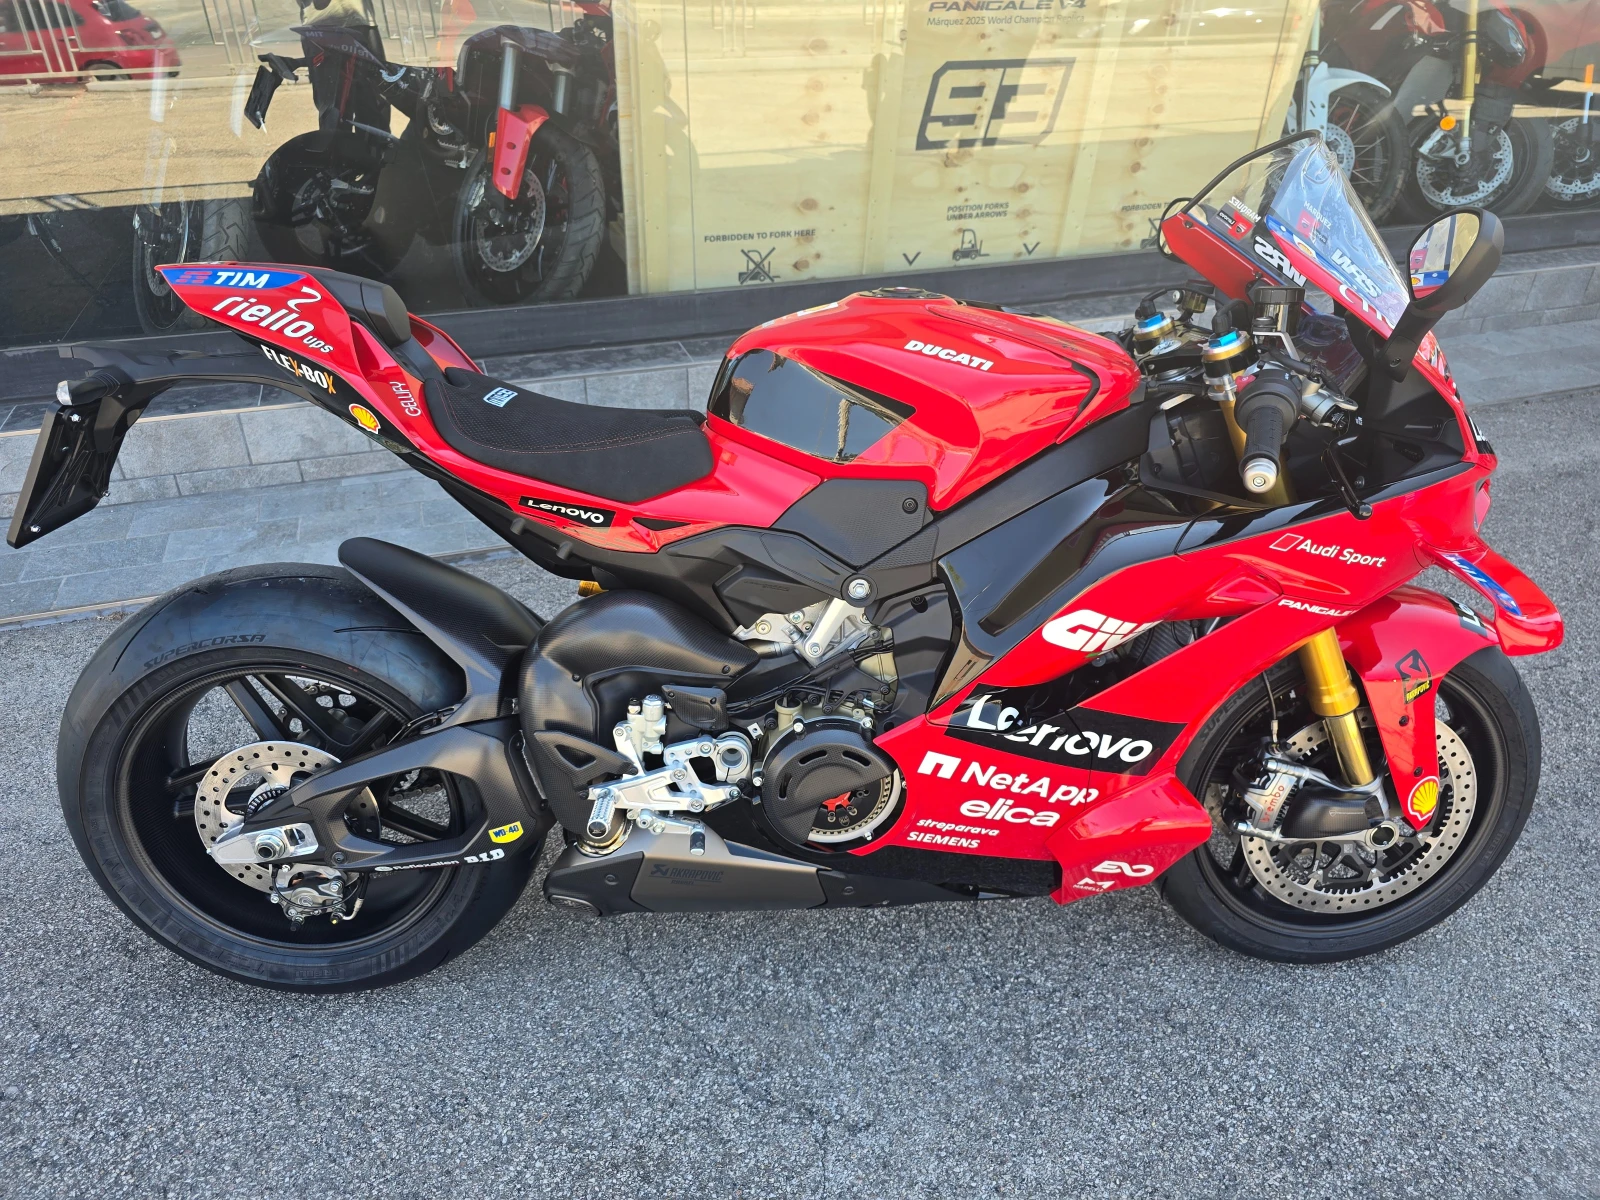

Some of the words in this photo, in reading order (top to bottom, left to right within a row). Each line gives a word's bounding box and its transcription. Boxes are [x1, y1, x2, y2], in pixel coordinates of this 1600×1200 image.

[927, 17, 964, 27] Márquez
[966, 16, 986, 24] 2025
[988, 15, 1012, 24] World
[946, 213, 972, 221] UNDER
[974, 210, 1007, 220] ARROWS
[947, 204, 981, 213] POSITION
[984, 202, 1009, 211] FORKS
[704, 233, 754, 243] FORBIDDEN
[757, 232, 768, 240] TO
[769, 230, 792, 239] FORK
[794, 229, 816, 238] HERE
[214, 271, 270, 289] TIM
[212, 296, 314, 338] riello
[302, 335, 334, 353] ups
[904, 339, 994, 372] DUCATI
[260, 344, 337, 395] FLEX-BOX
[527, 499, 604, 524] Lenovo
[1296, 538, 1341, 558] Audi
[1342, 548, 1387, 568] Sport
[143, 634, 267, 672] SUPERCORSA
[960, 761, 1099, 805] NetApp
[959, 798, 1060, 828] elica
[1260, 784, 1285, 824] brembo
[493, 824, 520, 839] WD-40
[916, 818, 1000, 837] streparava
[907, 831, 981, 849] SIEMENS
